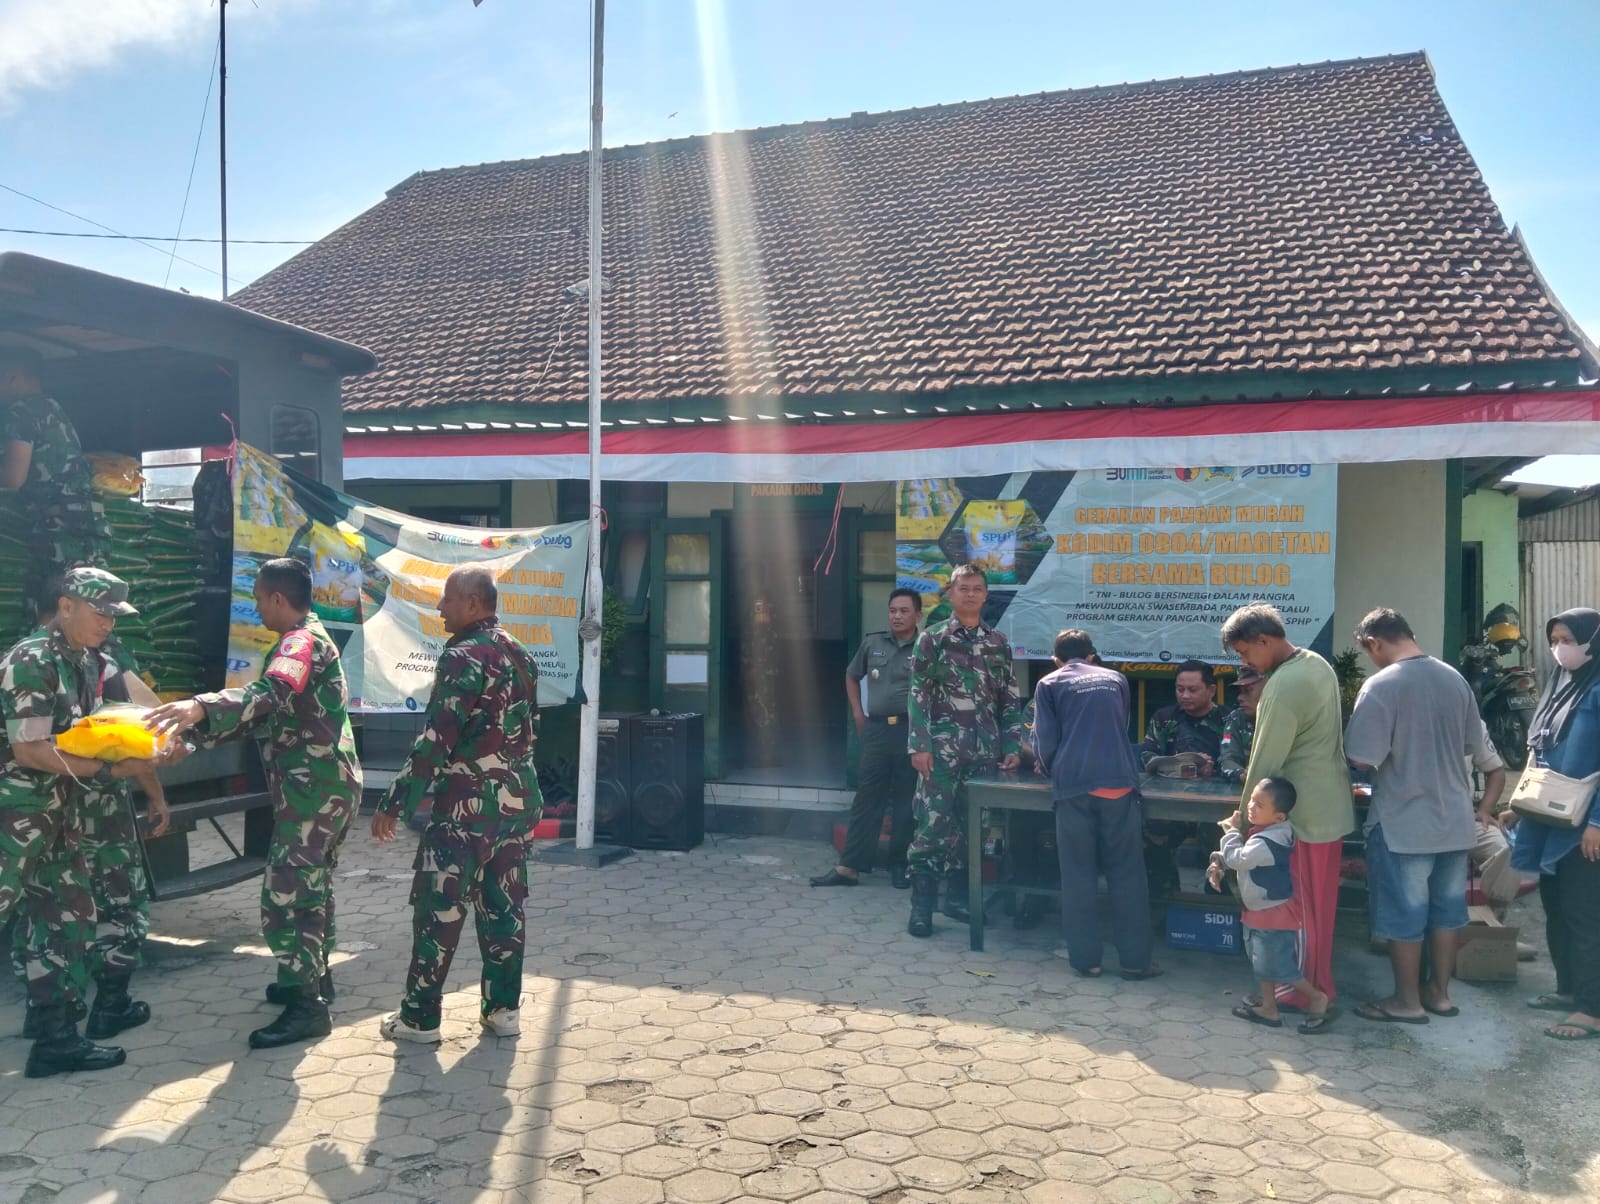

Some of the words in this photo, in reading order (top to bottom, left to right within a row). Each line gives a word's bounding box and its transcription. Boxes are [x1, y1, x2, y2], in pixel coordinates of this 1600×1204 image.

[1075, 507, 1155, 524] GERAKAN
[1159, 506, 1231, 523] PANGAN
[1235, 505, 1304, 522] MURAH
[1056, 533, 1132, 554] KODIM
[1139, 531, 1330, 555] 0804/MAGETAN
[1091, 562, 1204, 585] BERSAMA
[1209, 563, 1291, 586] BULOG
[1096, 590, 1111, 598] TNI
[1119, 591, 1151, 599] BULOG
[1153, 591, 1212, 600] BERSINERGI
[1213, 592, 1250, 600] DALAM
[1252, 593, 1295, 601] RANGKA
[1075, 602, 1145, 610] MEWUJUDKAN
[1147, 602, 1217, 611] SWASEMBADA
[1066, 613, 1114, 621] PROGRAM
[1165, 614, 1208, 622] PANGAN
[1285, 617, 1312, 625] SPHP
[395, 662, 435, 673] PROGRA
